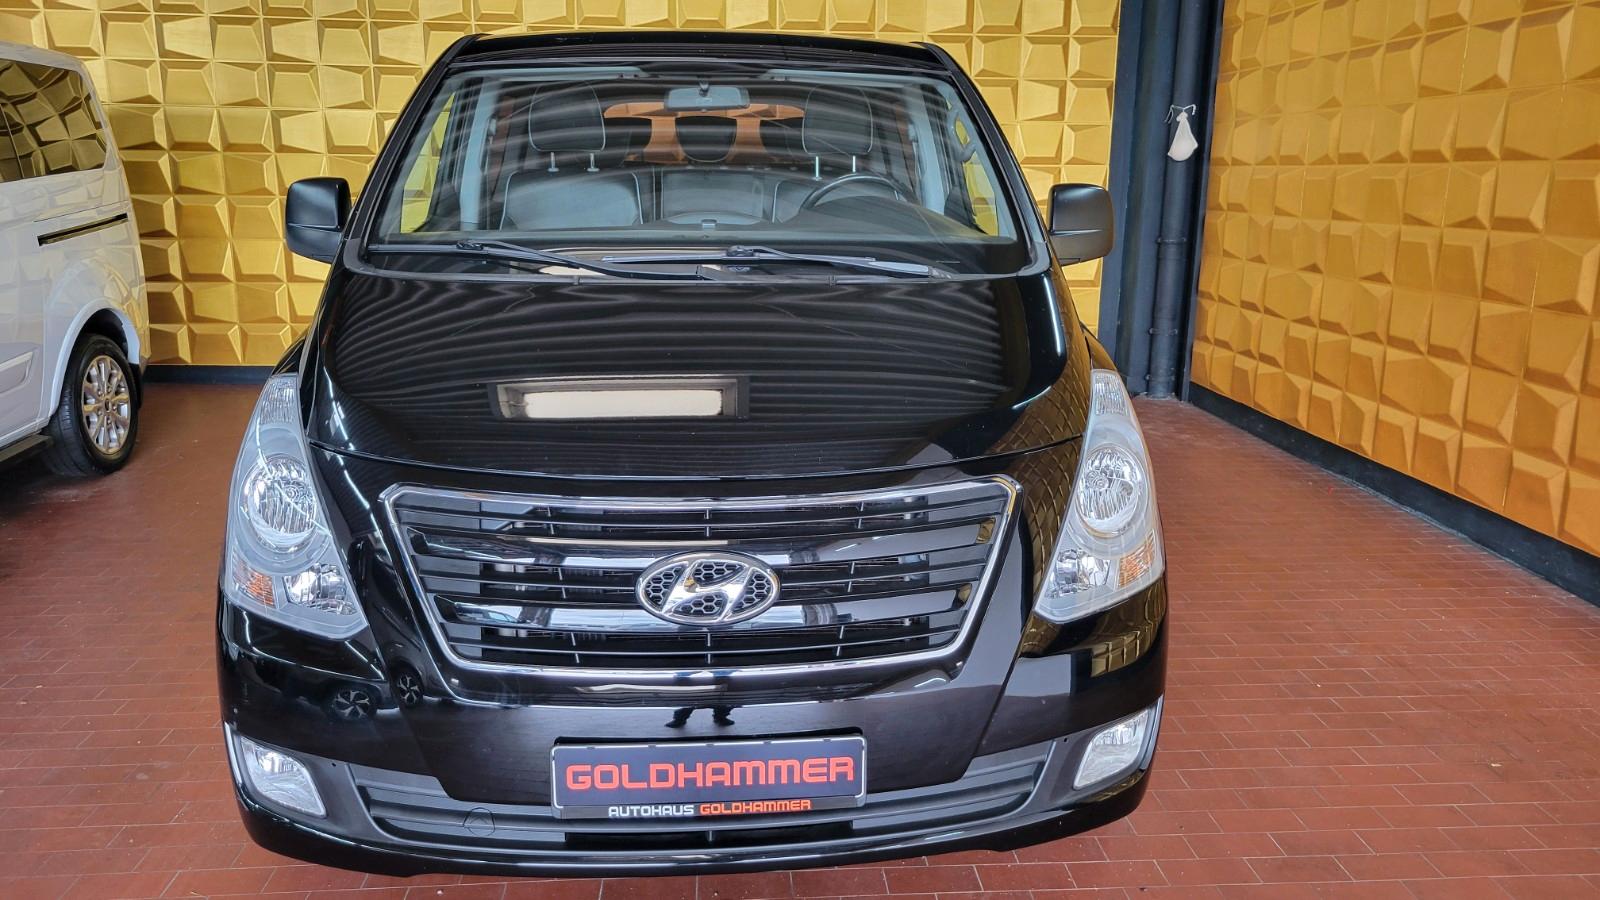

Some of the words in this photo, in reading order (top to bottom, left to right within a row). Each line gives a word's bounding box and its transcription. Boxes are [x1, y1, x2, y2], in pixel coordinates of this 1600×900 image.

[565, 756, 855, 790] GOLDHAMMER
[608, 804, 694, 818] AUTOHAUS
[699, 799, 812, 816] GOLDHAMMER
